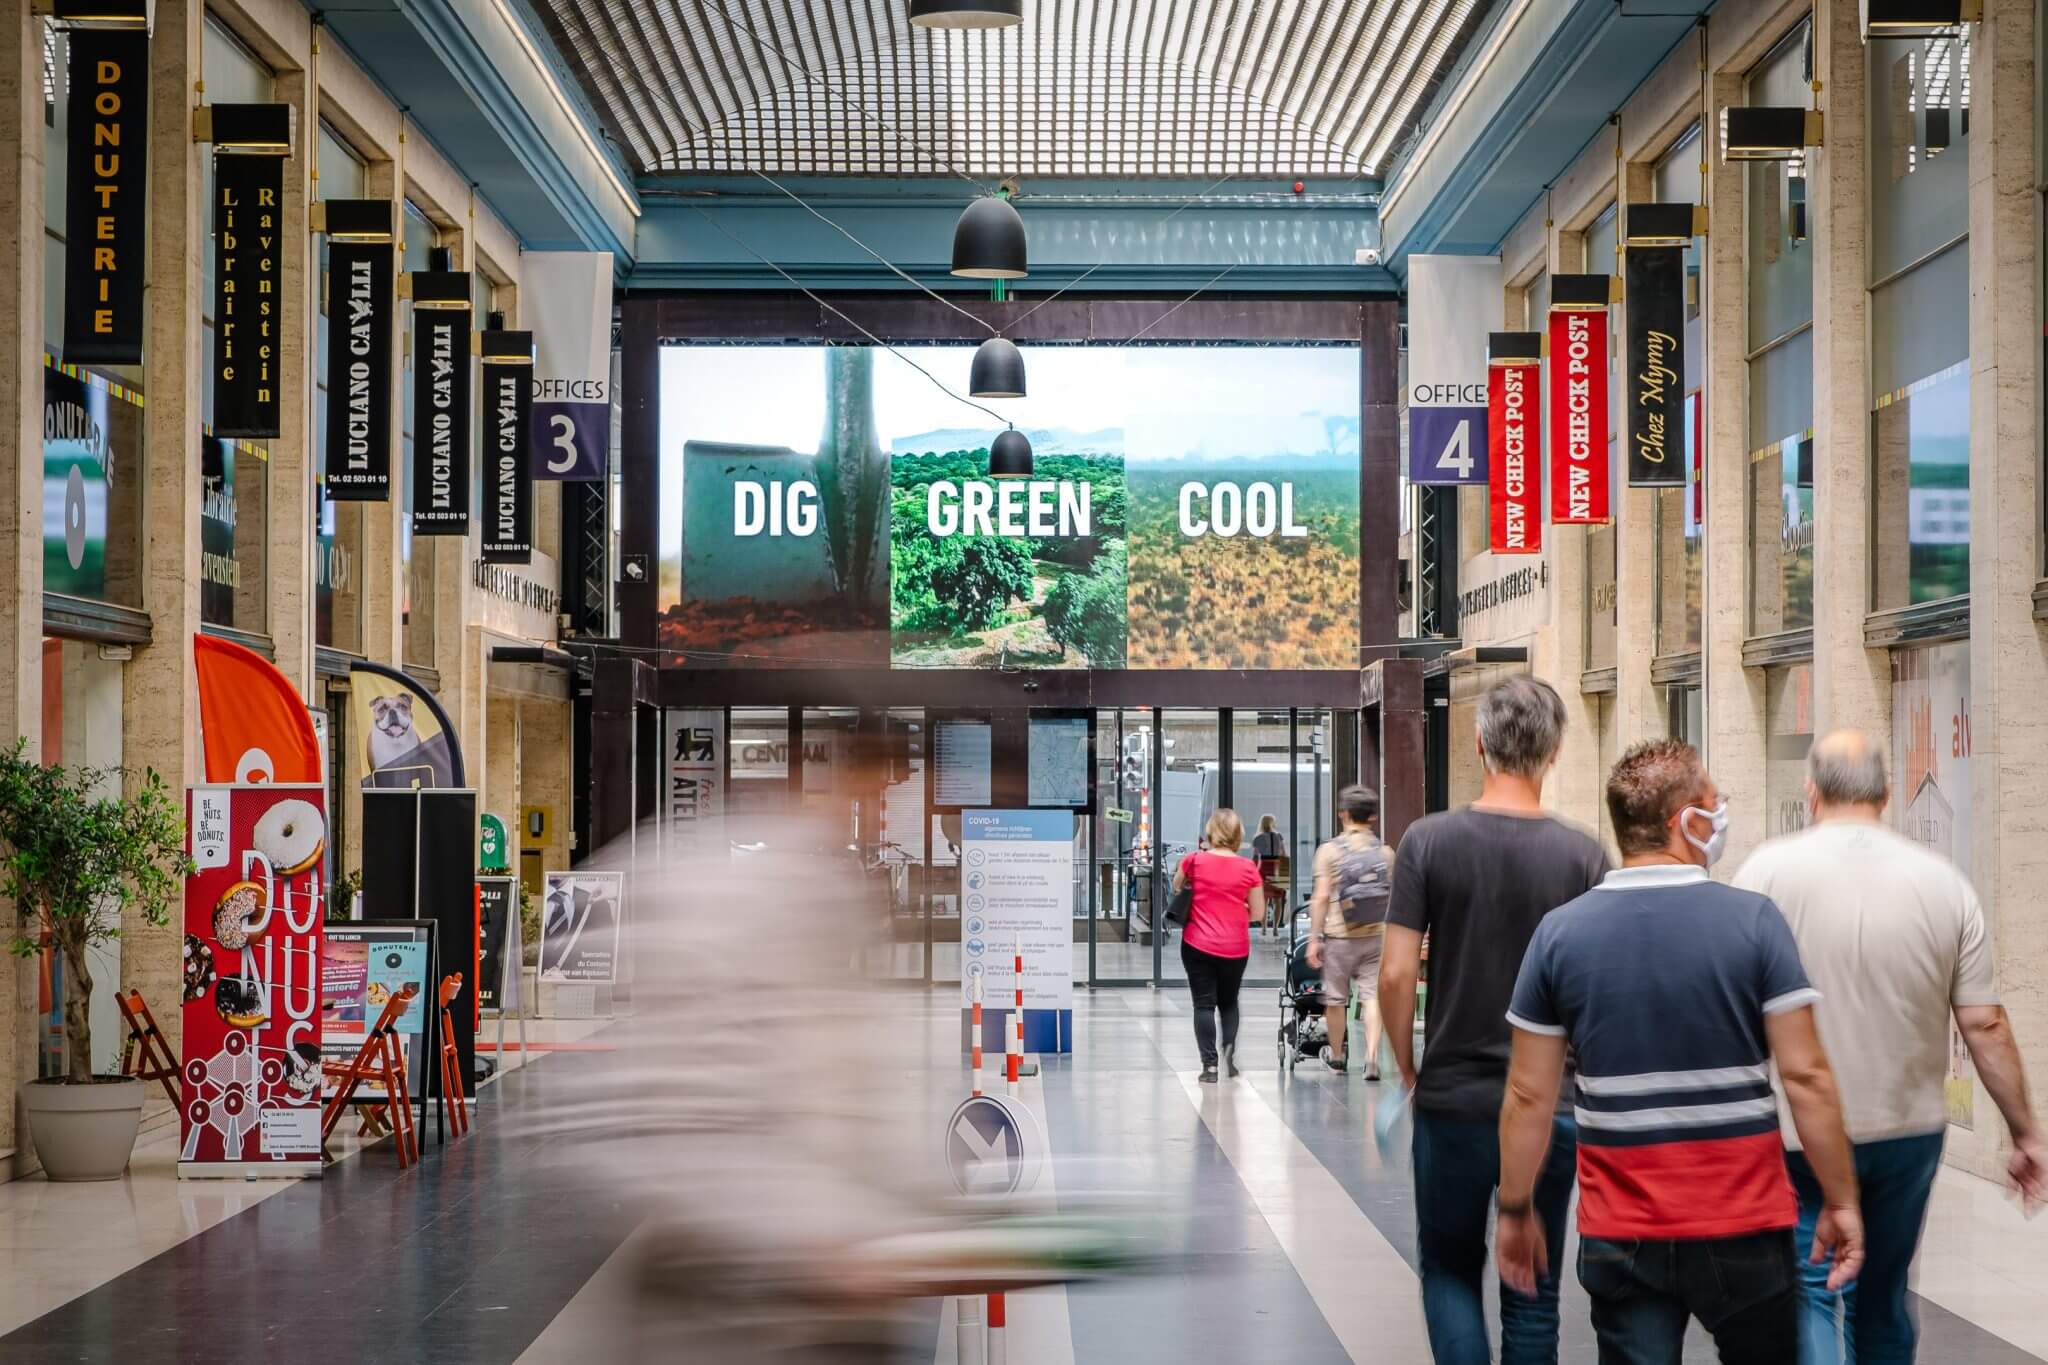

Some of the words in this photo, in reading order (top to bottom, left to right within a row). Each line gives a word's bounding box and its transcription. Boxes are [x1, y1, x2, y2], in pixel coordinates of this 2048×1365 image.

[94, 61, 121, 333] DONUTERIE
[223, 188, 238, 380] Librairie
[258, 188, 275, 402] Ravenstein
[1568, 315, 1590, 375] POST
[348, 362, 370, 469] LUCIANO
[1414, 384, 1489, 403] OFFICE
[1505, 369, 1523, 421] POST
[1569, 378, 1590, 460] CHECK
[433, 414, 451, 507] LUCIANO
[547, 414, 578, 473] 3
[1436, 419, 1474, 478] 4
[1505, 423, 1524, 497] CHECK
[1636, 412, 1664, 463] Chez
[498, 456, 516, 540] LUCIANO
[734, 481, 818, 537] DIG
[927, 480, 1092, 537] GREEN
[1178, 481, 1308, 537] COOL
[1569, 465, 1590, 519] NEW
[1507, 500, 1525, 548] NEW
[200, 820, 209, 831] BE
[203, 799, 212, 809] BE
[968, 816, 1000, 825] COVID-19
